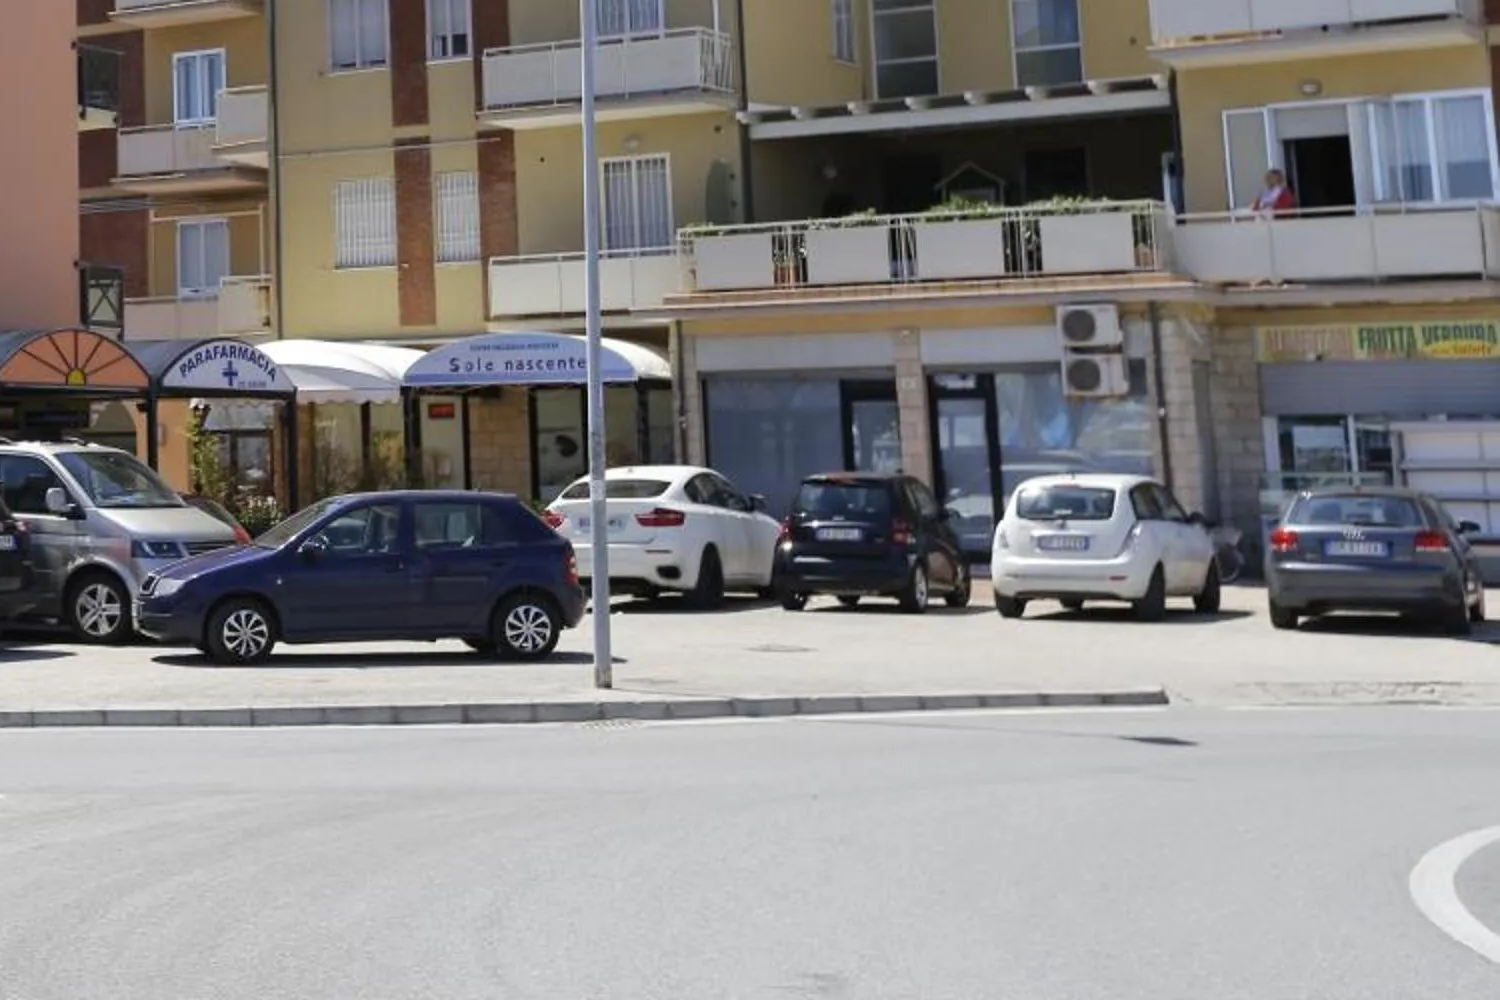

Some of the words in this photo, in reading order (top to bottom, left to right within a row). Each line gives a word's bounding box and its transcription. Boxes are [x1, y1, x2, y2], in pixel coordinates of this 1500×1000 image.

[1358, 325, 1417, 357] FRUTTA
[179, 345, 277, 382] PARAFARMACIA
[449, 357, 494, 373] Sole
[504, 355, 588, 372] nascente
